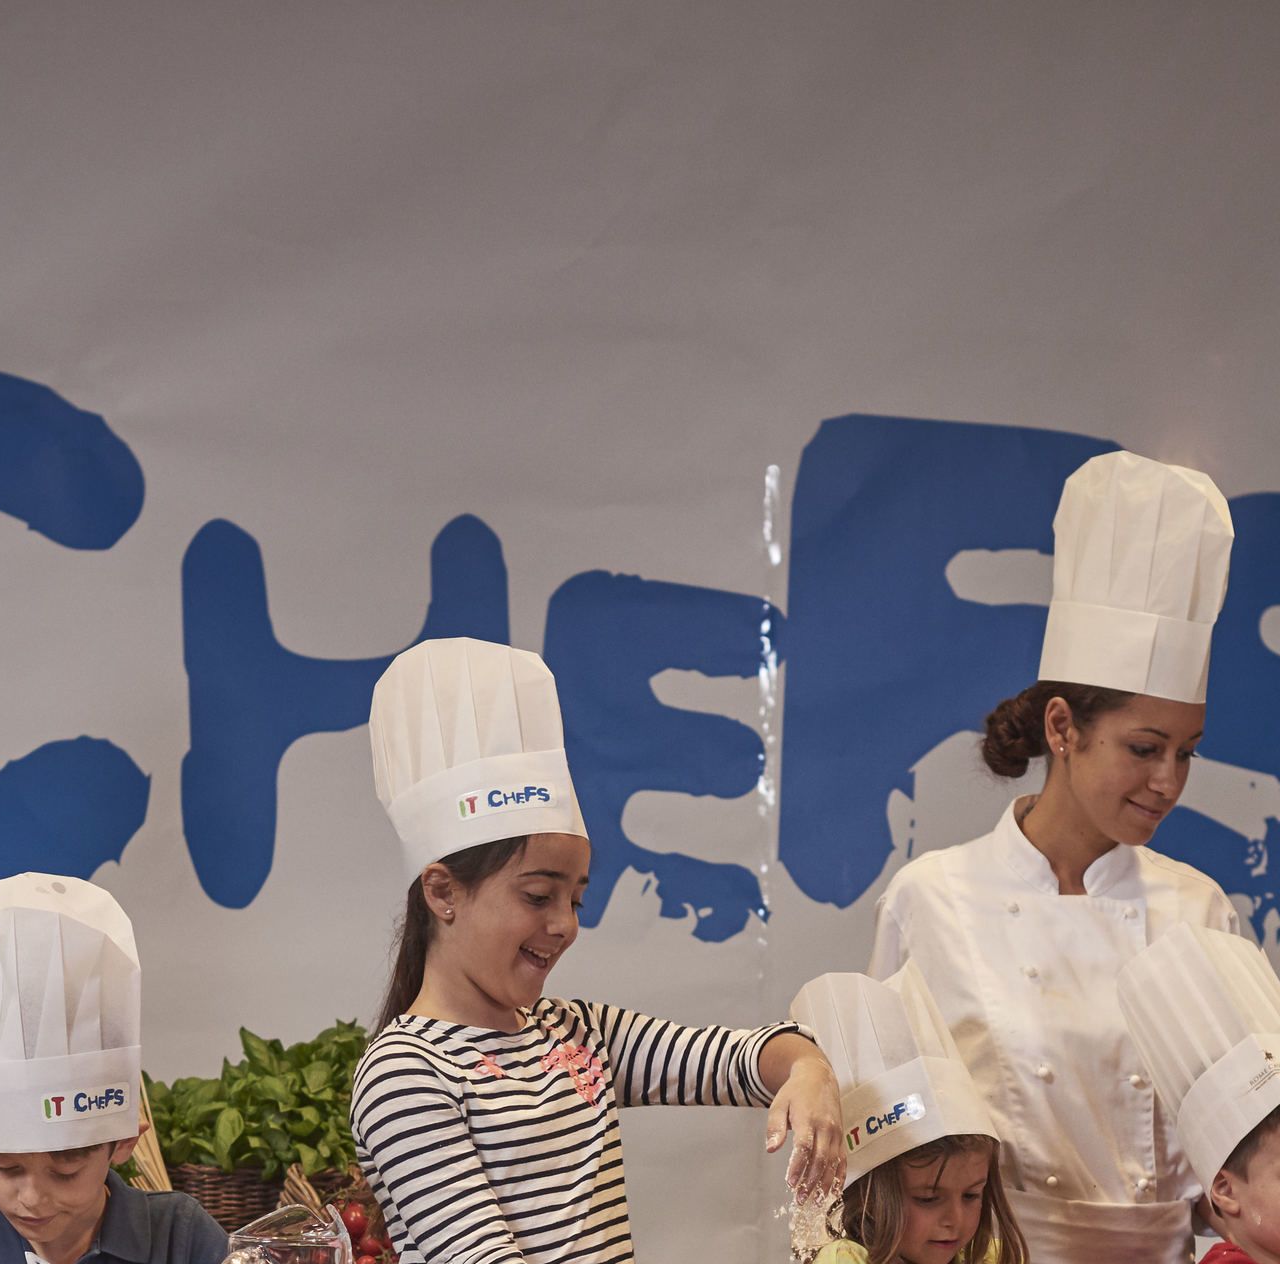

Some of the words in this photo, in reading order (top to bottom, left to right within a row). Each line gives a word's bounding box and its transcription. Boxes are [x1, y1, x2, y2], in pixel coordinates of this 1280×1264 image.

[459, 796, 479, 818] IT
[487, 785, 551, 808] CHEFS
[44, 1096, 65, 1119] IT
[73, 1088, 125, 1113] CHEFS
[846, 1126, 861, 1151] IT
